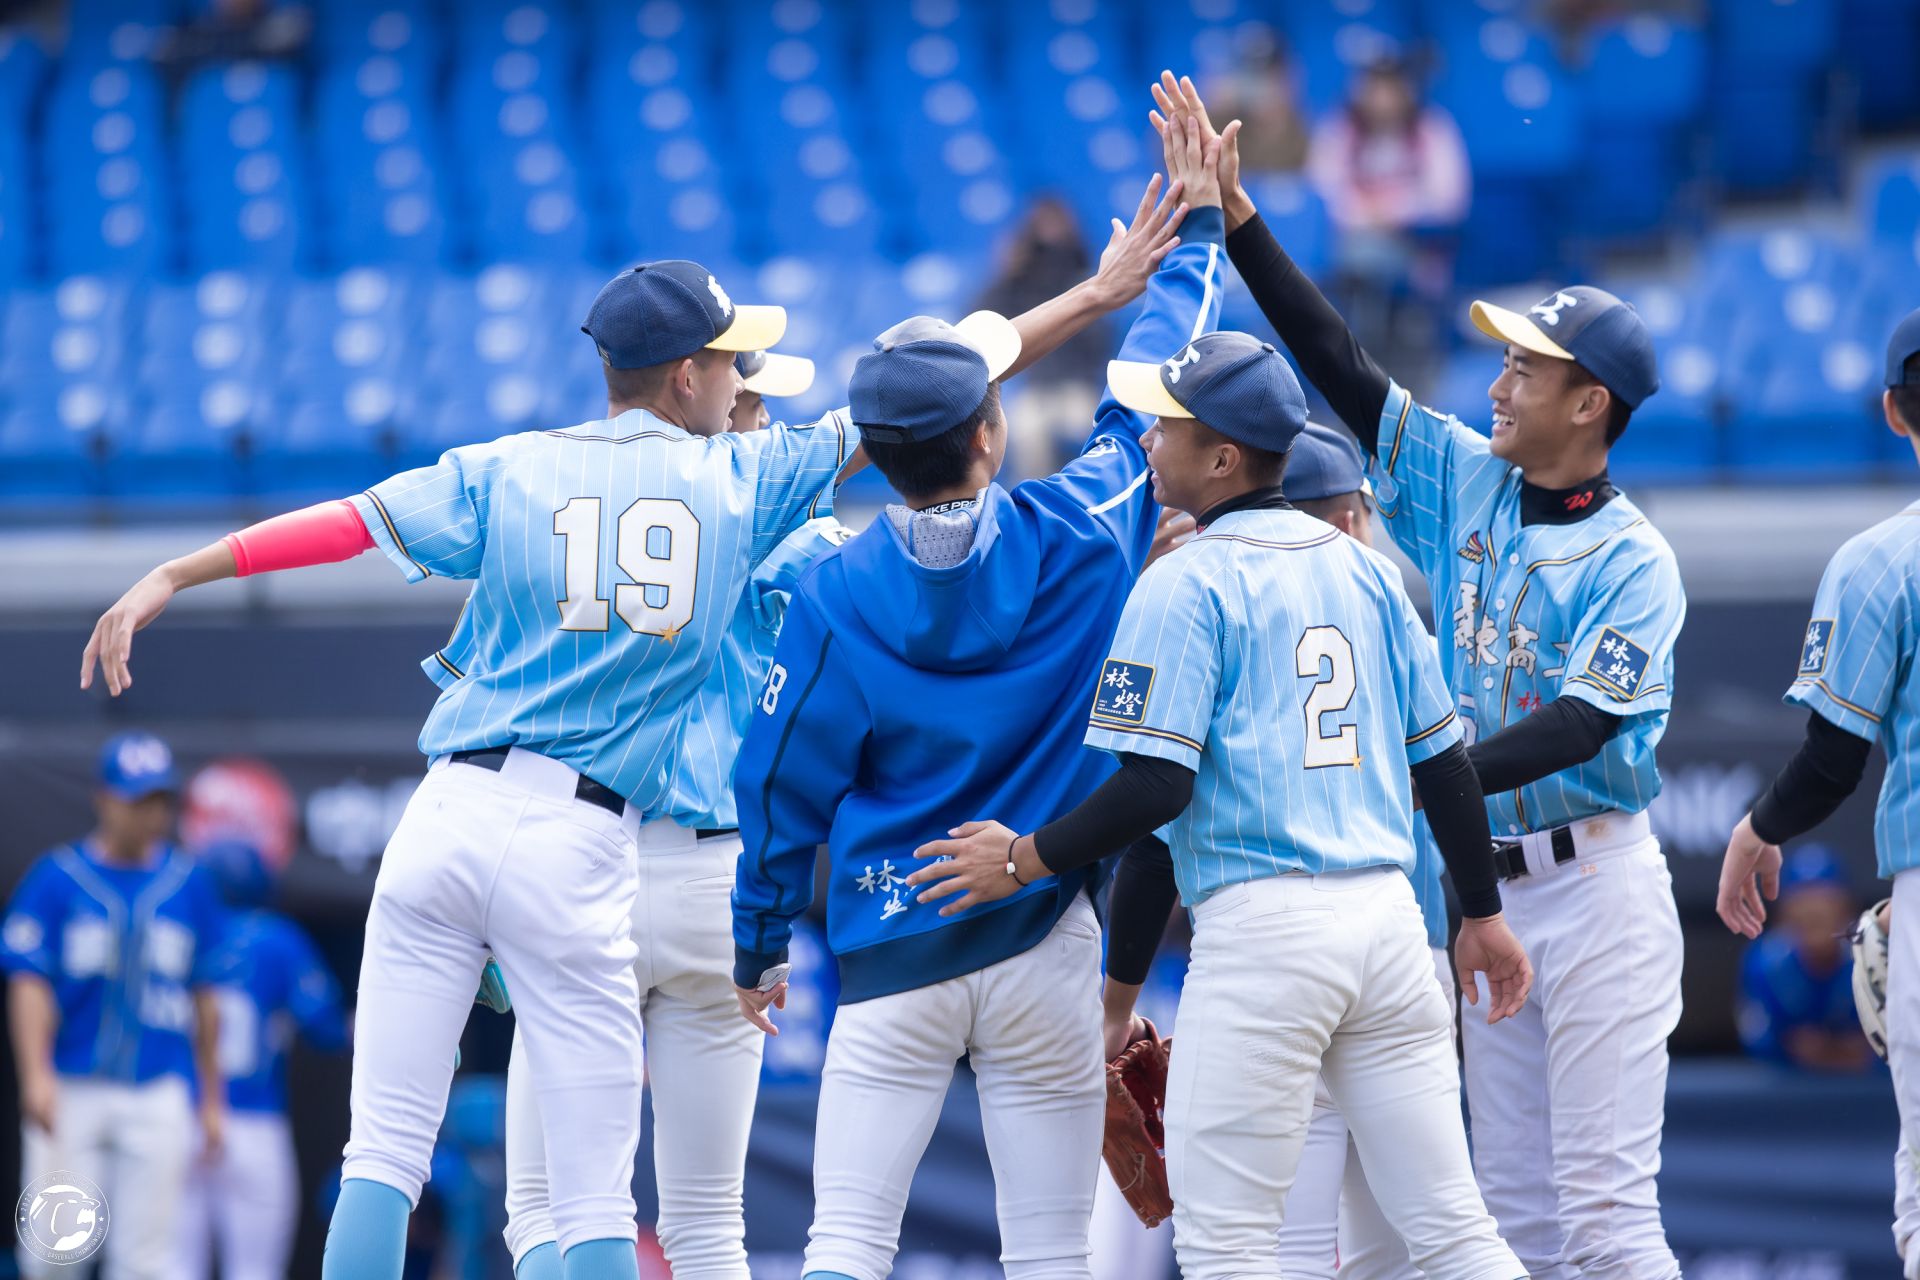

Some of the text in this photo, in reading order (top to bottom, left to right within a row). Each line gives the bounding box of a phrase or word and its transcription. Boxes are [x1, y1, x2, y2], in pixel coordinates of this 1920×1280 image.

[919, 503, 950, 516] NIKE
[553, 497, 701, 637] 19
[757, 656, 787, 715] 8
[1296, 624, 1357, 770] 2
